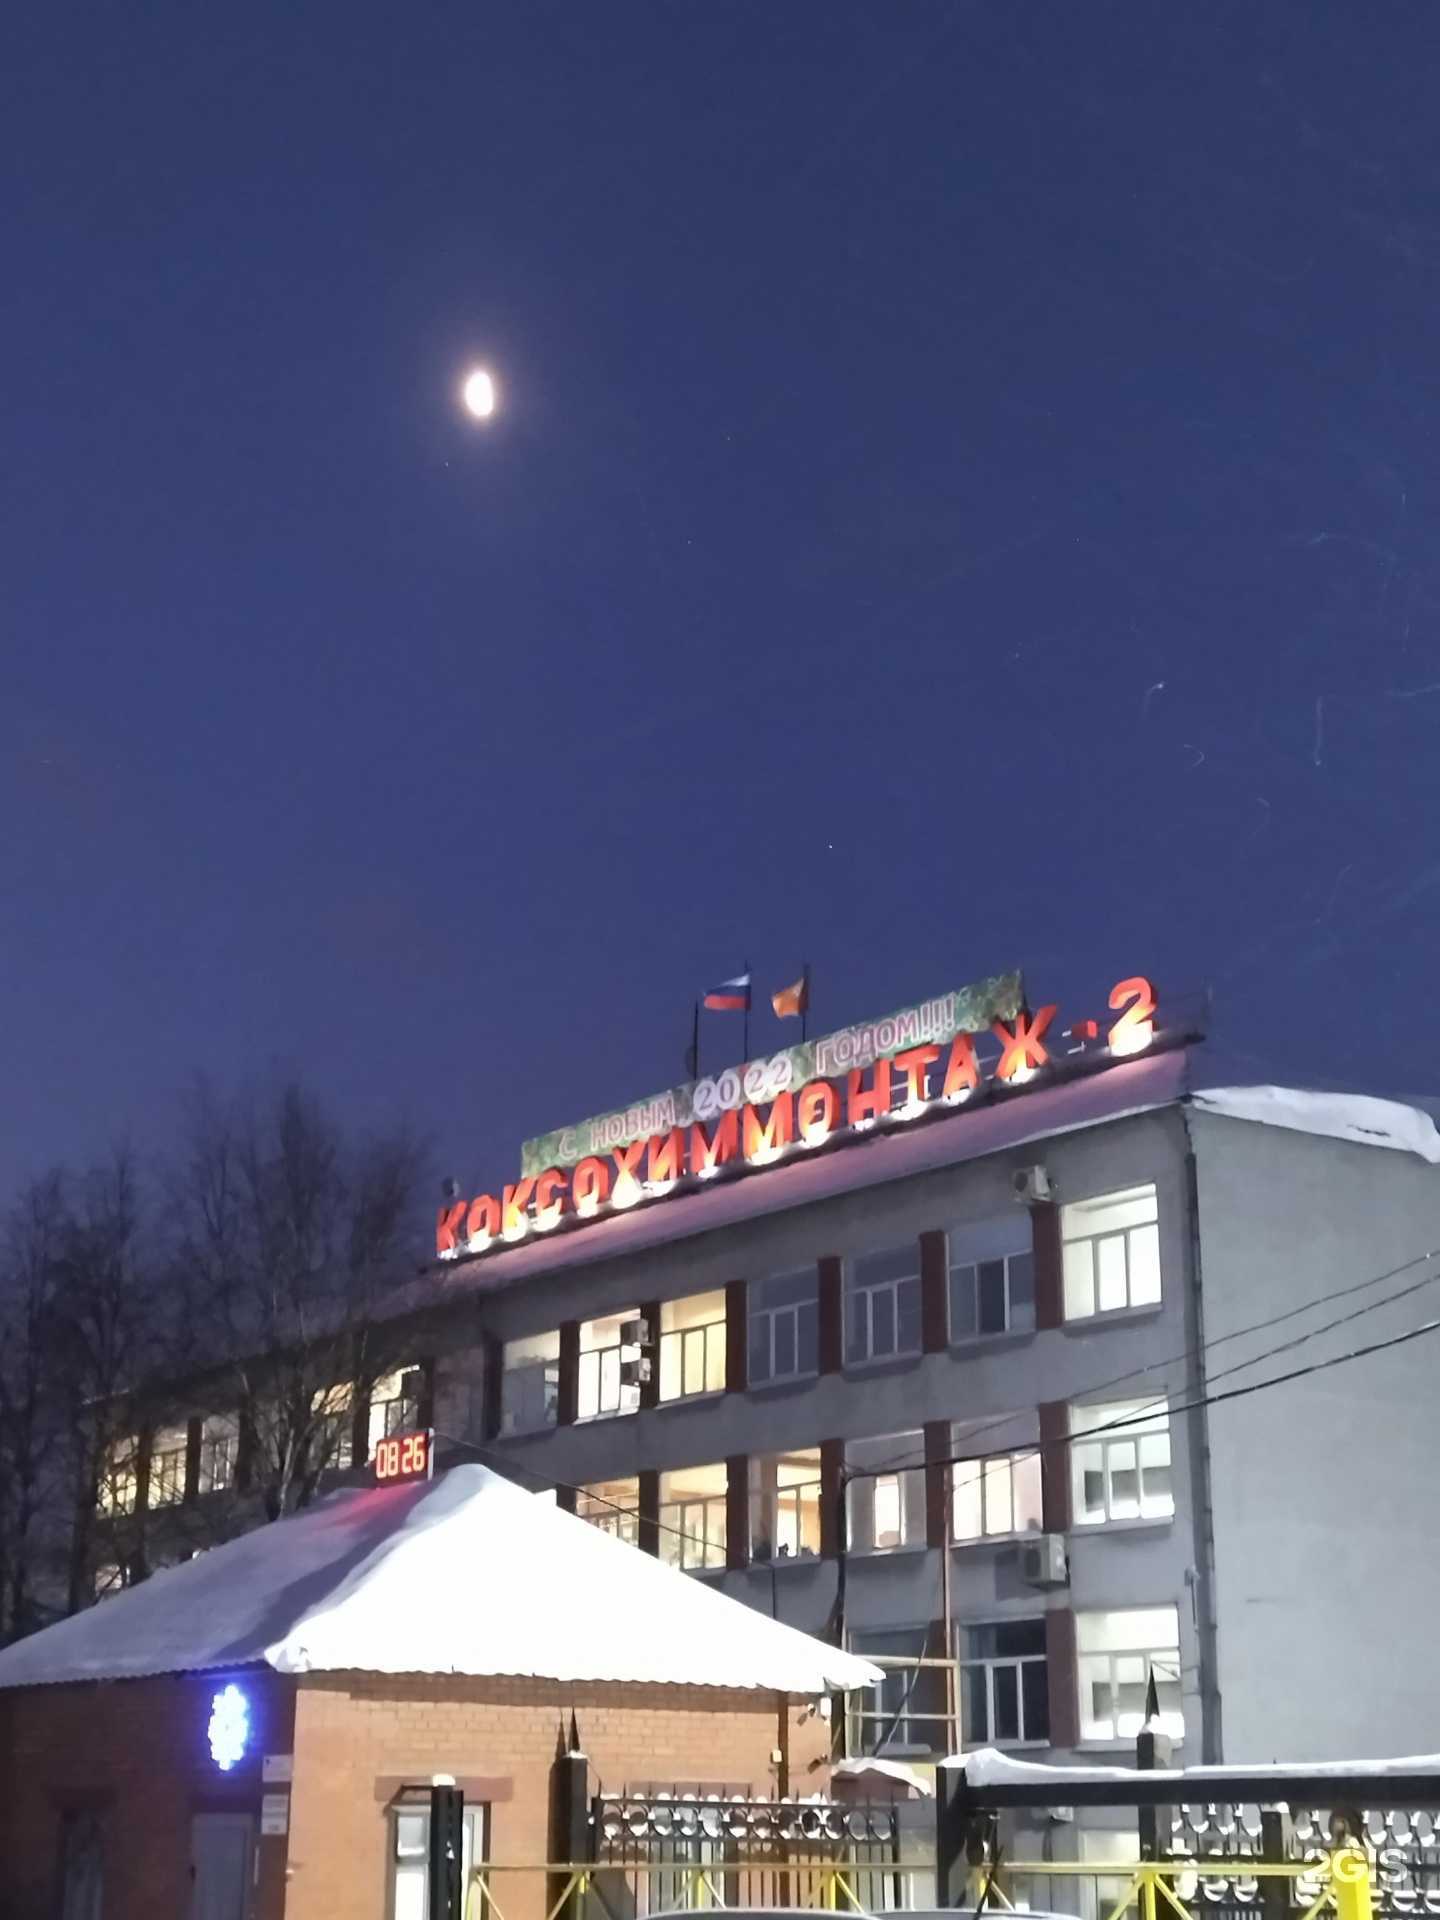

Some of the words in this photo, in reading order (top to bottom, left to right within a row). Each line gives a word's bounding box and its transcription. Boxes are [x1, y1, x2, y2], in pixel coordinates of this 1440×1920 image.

[436, 1004, 1057, 1253] КОКСОХИММОНТАЖ
[1108, 976, 1157, 1057] 2
[590, 1093, 676, 1151] НОВЫМ
[693, 1055, 793, 1118] 2022
